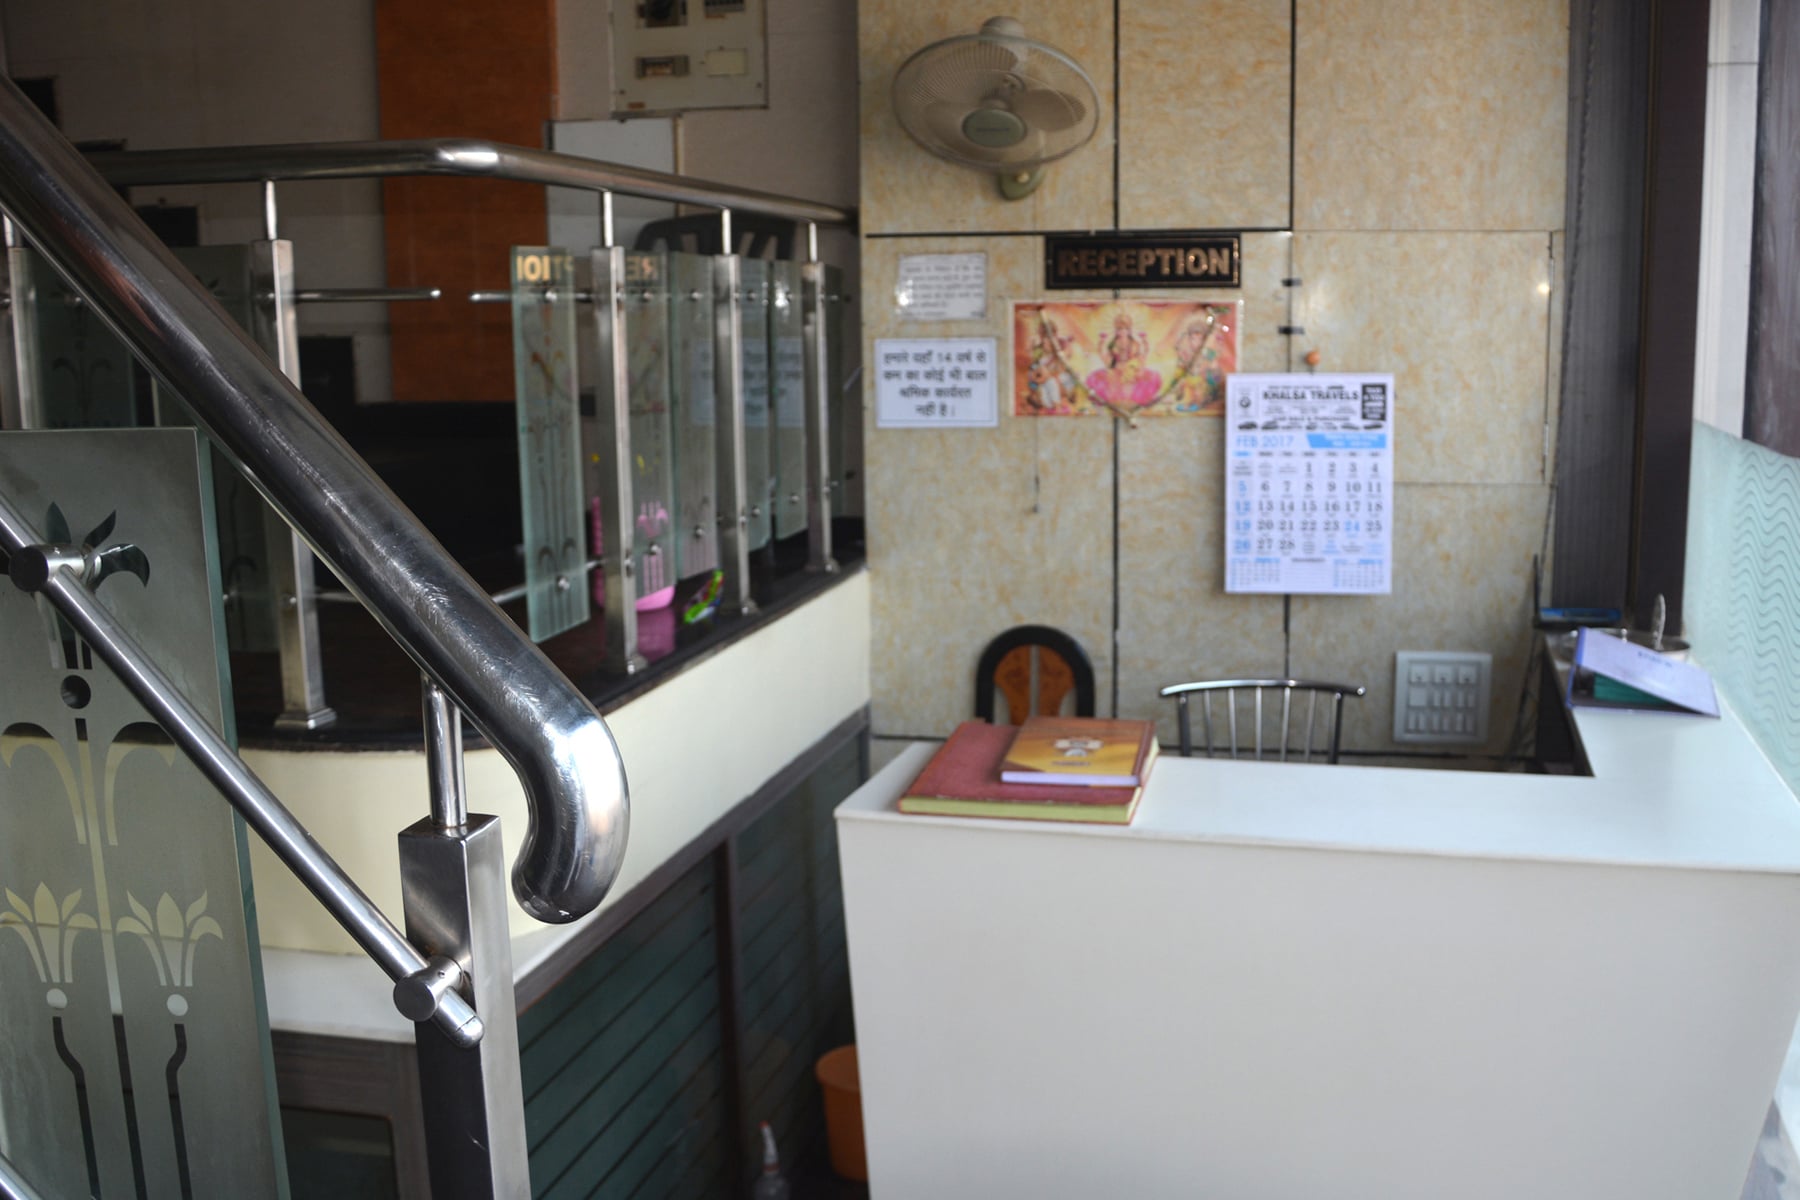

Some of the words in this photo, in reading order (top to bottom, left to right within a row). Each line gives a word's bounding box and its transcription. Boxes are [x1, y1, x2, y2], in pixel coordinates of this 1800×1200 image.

[1058, 247, 1230, 276] RECEPTION
[1263, 391, 1306, 400] KHALSA
[1311, 391, 1359, 400] TRAVELS
[1235, 435, 1258, 448] FEB
[1262, 435, 1295, 448] 2017
[1306, 462, 1312, 473] 1
[1329, 462, 1336, 473] 2
[1349, 462, 1357, 473] 3
[1372, 462, 1379, 473] 4
[1239, 481, 1247, 492] 5
[1261, 481, 1270, 492] 6
[1283, 481, 1291, 492] 7
[1305, 481, 1313, 492] 8
[1328, 481, 1336, 492] 9
[1346, 481, 1361, 492] 10
[1367, 481, 1381, 492] 11
[1235, 500, 1250, 512] 12
[1258, 500, 1274, 512] 13
[1280, 500, 1295, 512] 14
[1302, 500, 1317, 512] 15
[1324, 500, 1340, 512] 16
[1345, 500, 1360, 512] 17
[1367, 500, 1383, 512] 18
[1235, 519, 1251, 532] 19
[1257, 519, 1274, 532] 20
[1279, 519, 1294, 532] 21
[1301, 519, 1317, 532] 22
[1323, 519, 1340, 532] 23
[1366, 519, 1382, 532] 25
[1257, 538, 1273, 550] 27
[1279, 538, 1295, 550] 28
